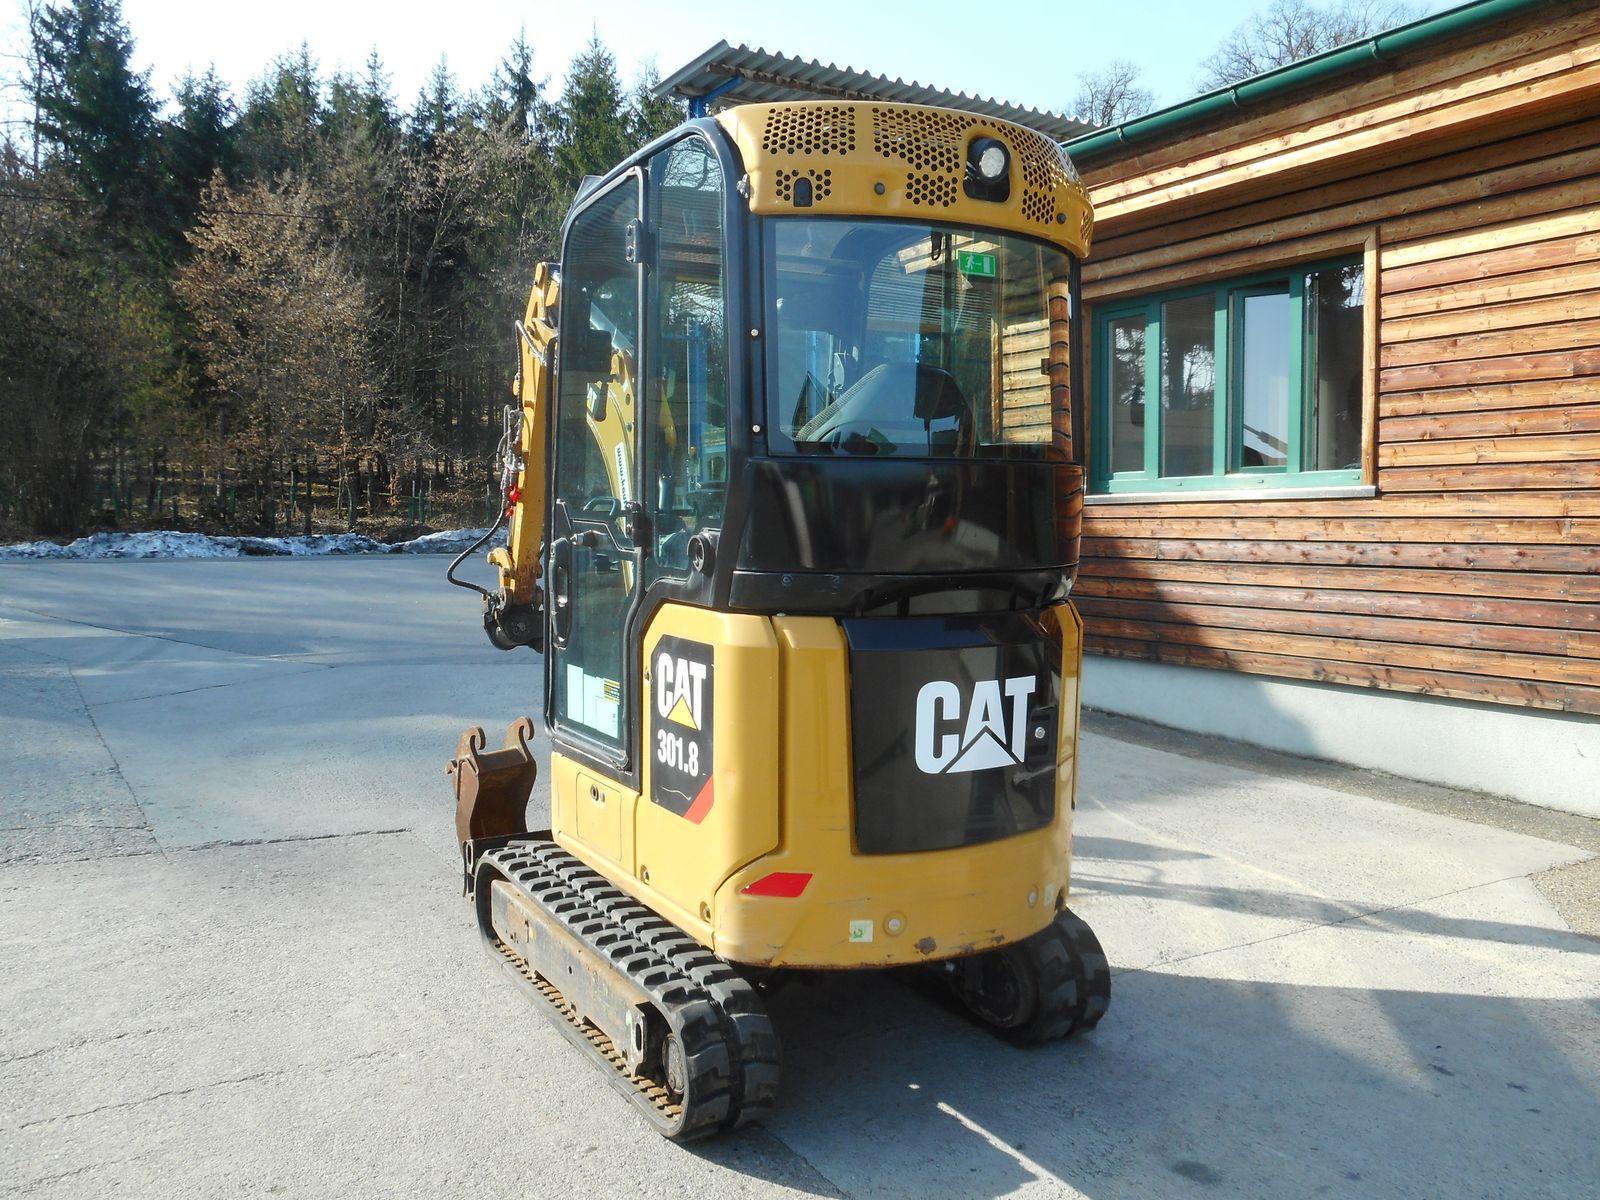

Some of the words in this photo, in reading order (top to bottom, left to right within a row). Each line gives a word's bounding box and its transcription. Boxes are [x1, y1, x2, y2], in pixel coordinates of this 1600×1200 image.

[657, 652, 706, 731] CAT
[915, 675, 1036, 775] CAT
[657, 728, 699, 777] 301.8
